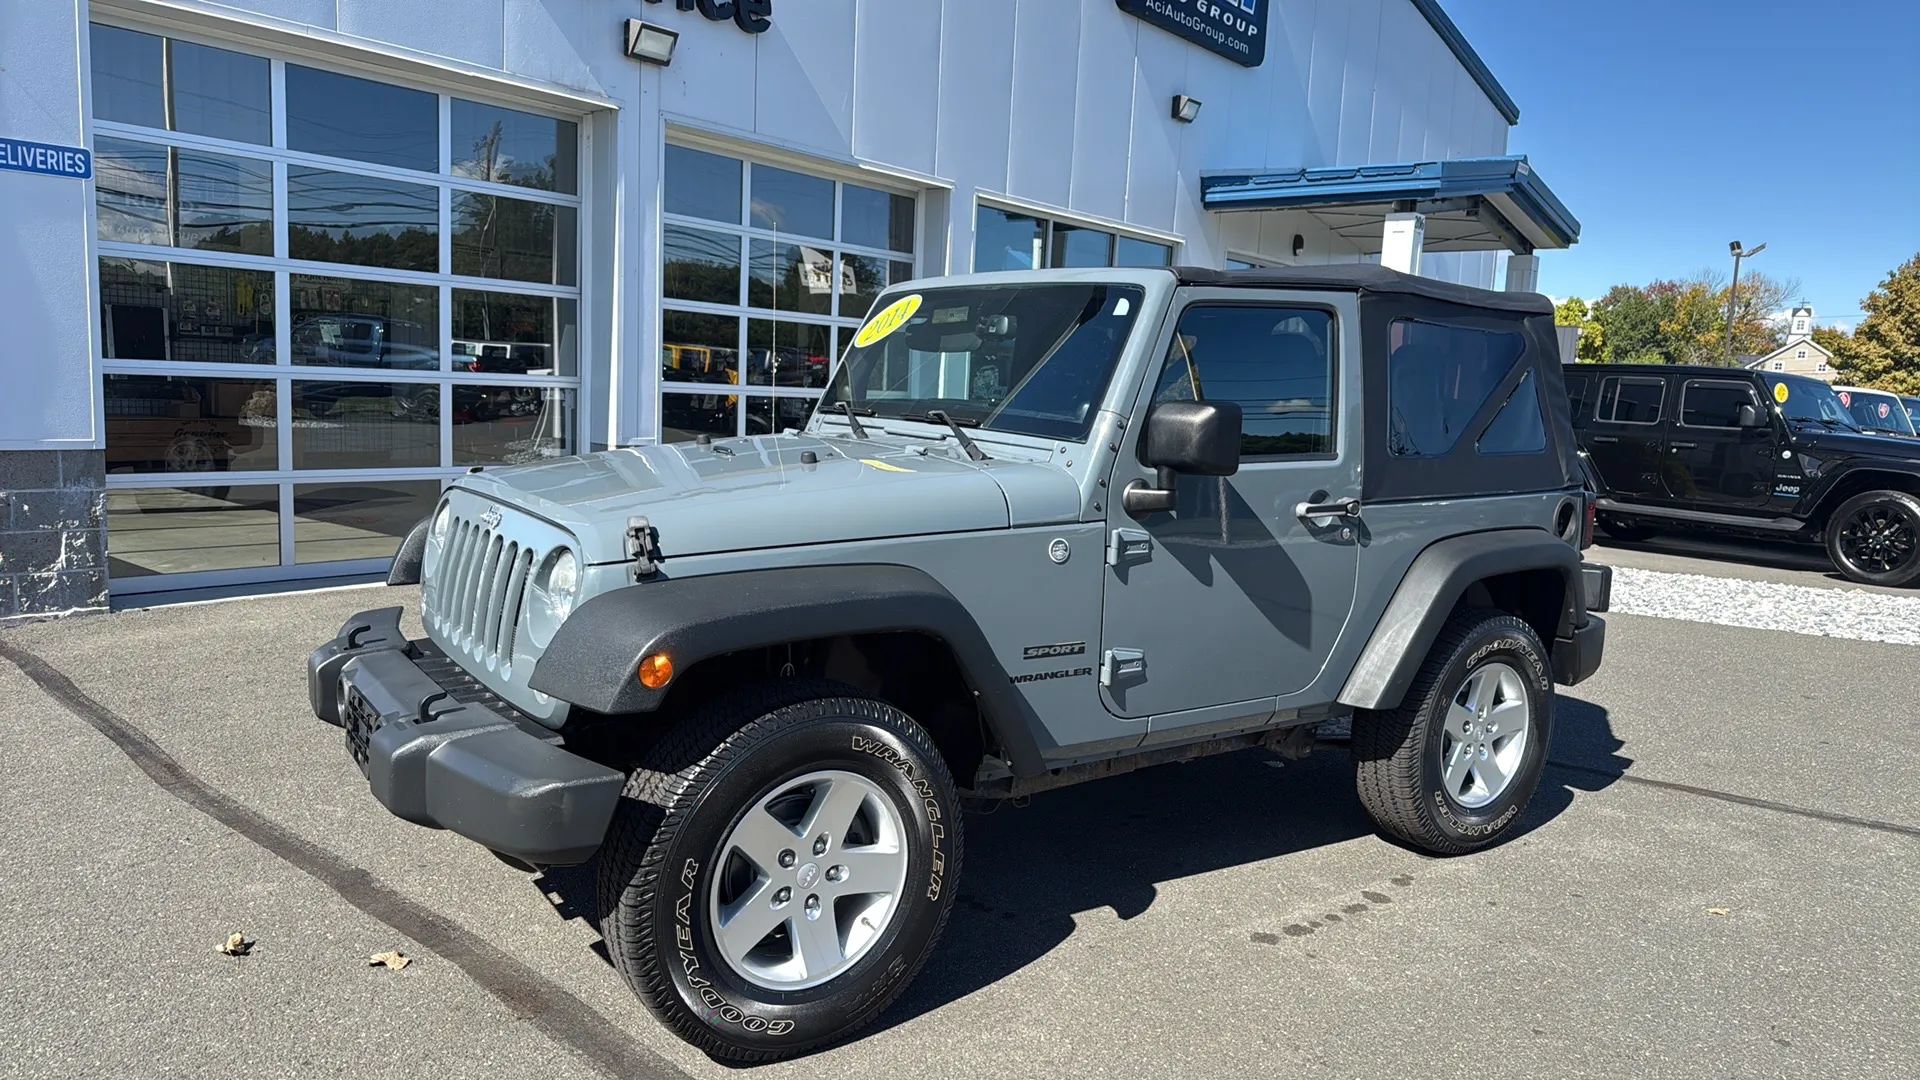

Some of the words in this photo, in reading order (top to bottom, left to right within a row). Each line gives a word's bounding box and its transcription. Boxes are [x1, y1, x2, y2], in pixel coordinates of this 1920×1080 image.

[1145, 0, 1249, 55] AciAutoGroup.com
[1196, 0, 1258, 36] GROUP
[863, 299, 912, 342] 2014
[1775, 483, 1800, 495] Jeep
[1025, 641, 1086, 657] SPORT
[1466, 638, 1549, 691] GOODYEAR
[1009, 667, 1093, 685] WRANGLER
[851, 735, 946, 902] WRANGLER
[674, 858, 796, 1036] GOODYEAR
